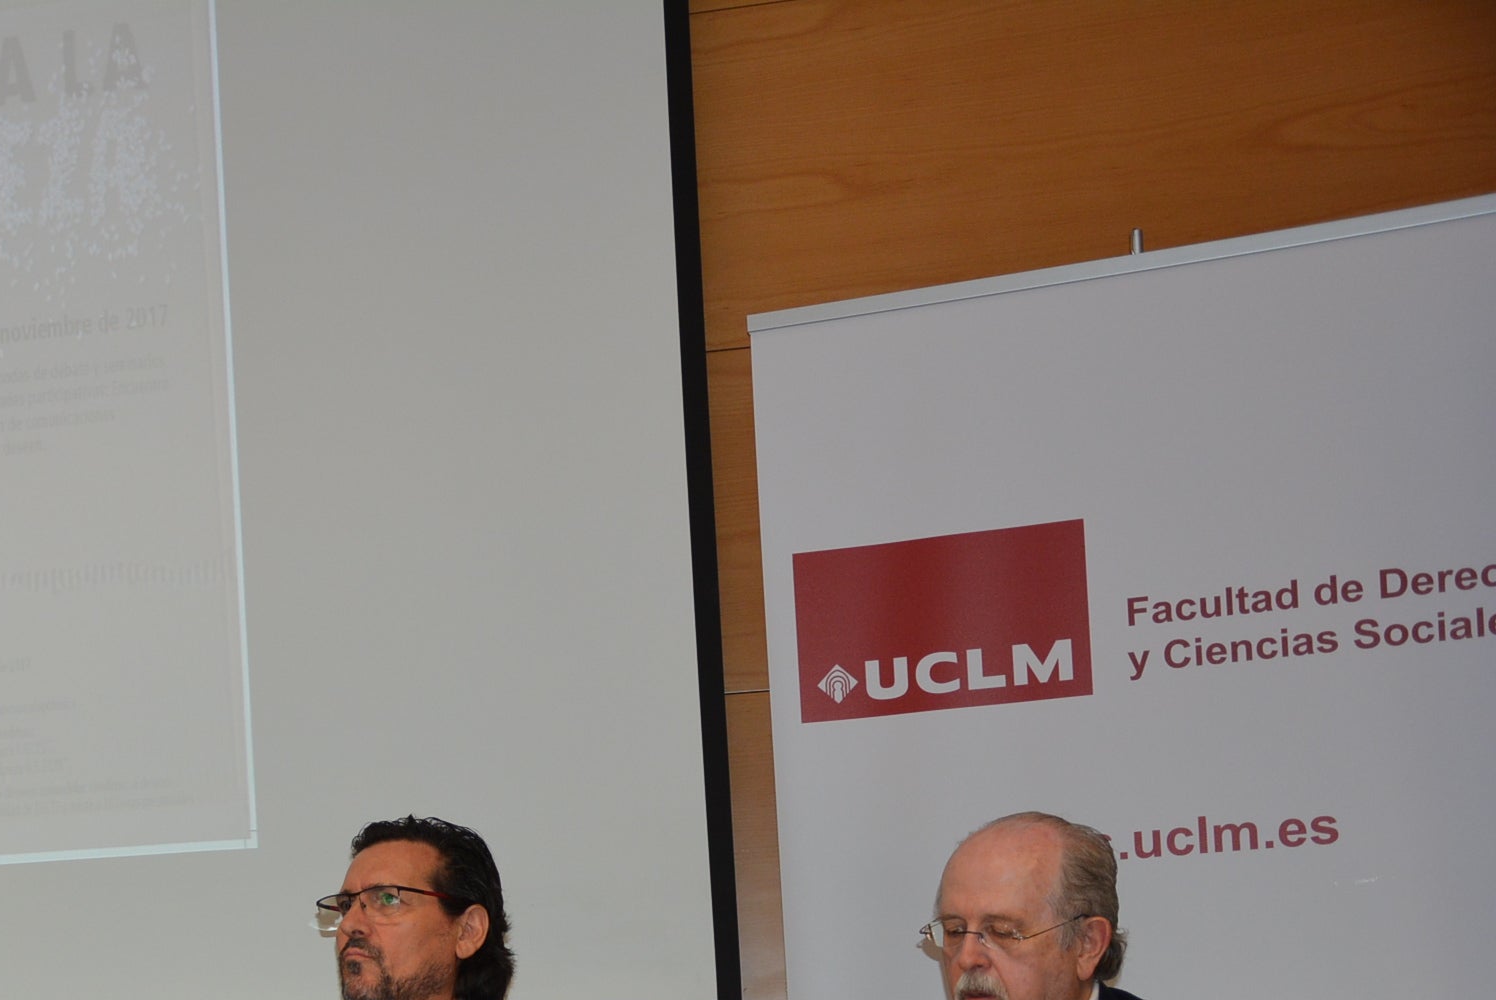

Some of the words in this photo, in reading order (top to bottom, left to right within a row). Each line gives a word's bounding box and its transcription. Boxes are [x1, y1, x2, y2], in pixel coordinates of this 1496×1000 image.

[61, 22, 150, 98] LA
[0, 313, 93, 345] noviembre
[97, 308, 120, 335] de
[125, 303, 169, 331] 2017
[1126, 579, 1299, 627] Facultad
[1313, 574, 1364, 608] de
[1379, 563, 1496, 600] Derec
[864, 638, 1075, 702] UCLM
[1127, 645, 1150, 681] y
[1163, 628, 1339, 670] Ciencias
[1102, 815, 1340, 860] .uclm.es
